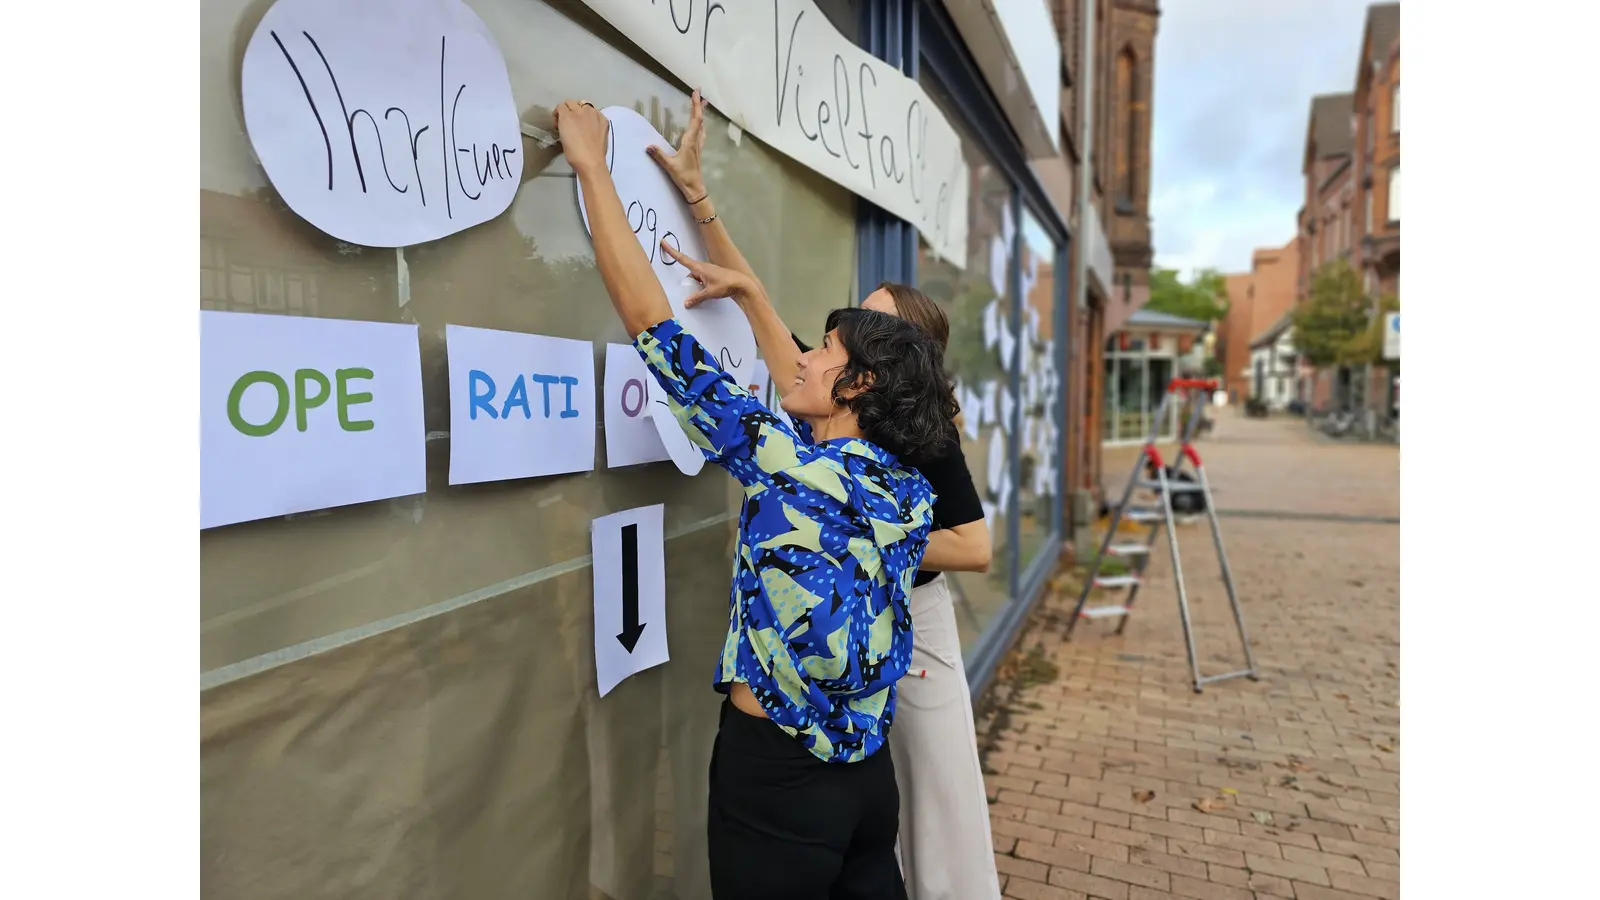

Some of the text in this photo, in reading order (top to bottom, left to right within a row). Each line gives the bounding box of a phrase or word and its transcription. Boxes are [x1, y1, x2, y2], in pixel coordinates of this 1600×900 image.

[774, 0, 928, 220] Vielfal
[226, 367, 375, 437] OPE
[469, 369, 579, 420] RATI
[621, 378, 650, 418] O
